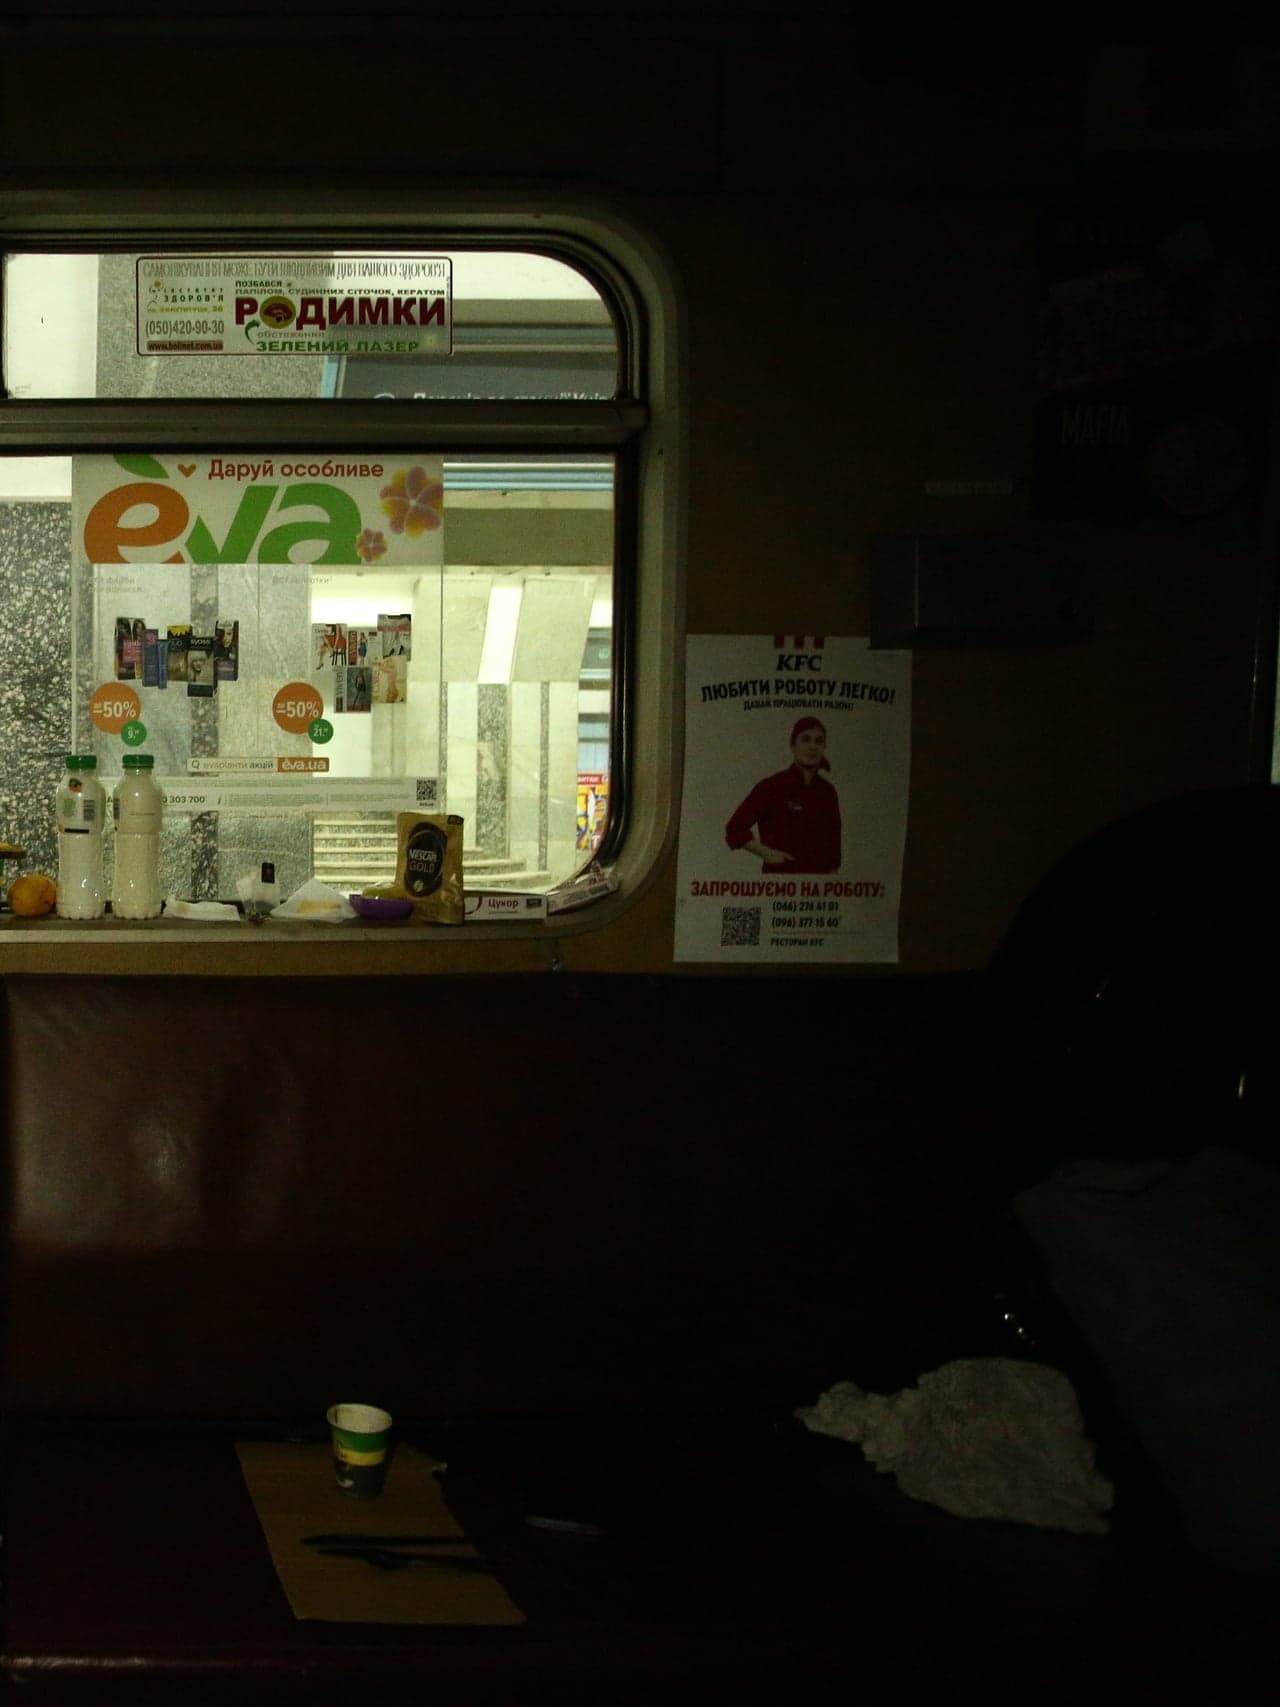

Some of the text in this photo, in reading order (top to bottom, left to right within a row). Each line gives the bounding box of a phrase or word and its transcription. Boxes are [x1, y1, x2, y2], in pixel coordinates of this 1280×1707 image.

[398, 288, 445, 296] КЕРАТОМ
[145, 319, 225, 338] (050)420-90-30
[255, 339, 420, 352] ЗЕЛЕНИЙ ЛАЗЕР
[208, 458, 385, 482] Даруй особливе
[775, 654, 823, 672] KFC
[701, 679, 896, 705] ЛЮБИТИ РОБОТУ ЛЕГКО!
[249, 759, 274, 771] акцій
[170, 795, 188, 804] 303
[189, 795, 206, 804] 700
[691, 881, 886, 898] ЗАПРОШУЄМО НА РОБОТУ:
[487, 897, 519, 909] Цукор
